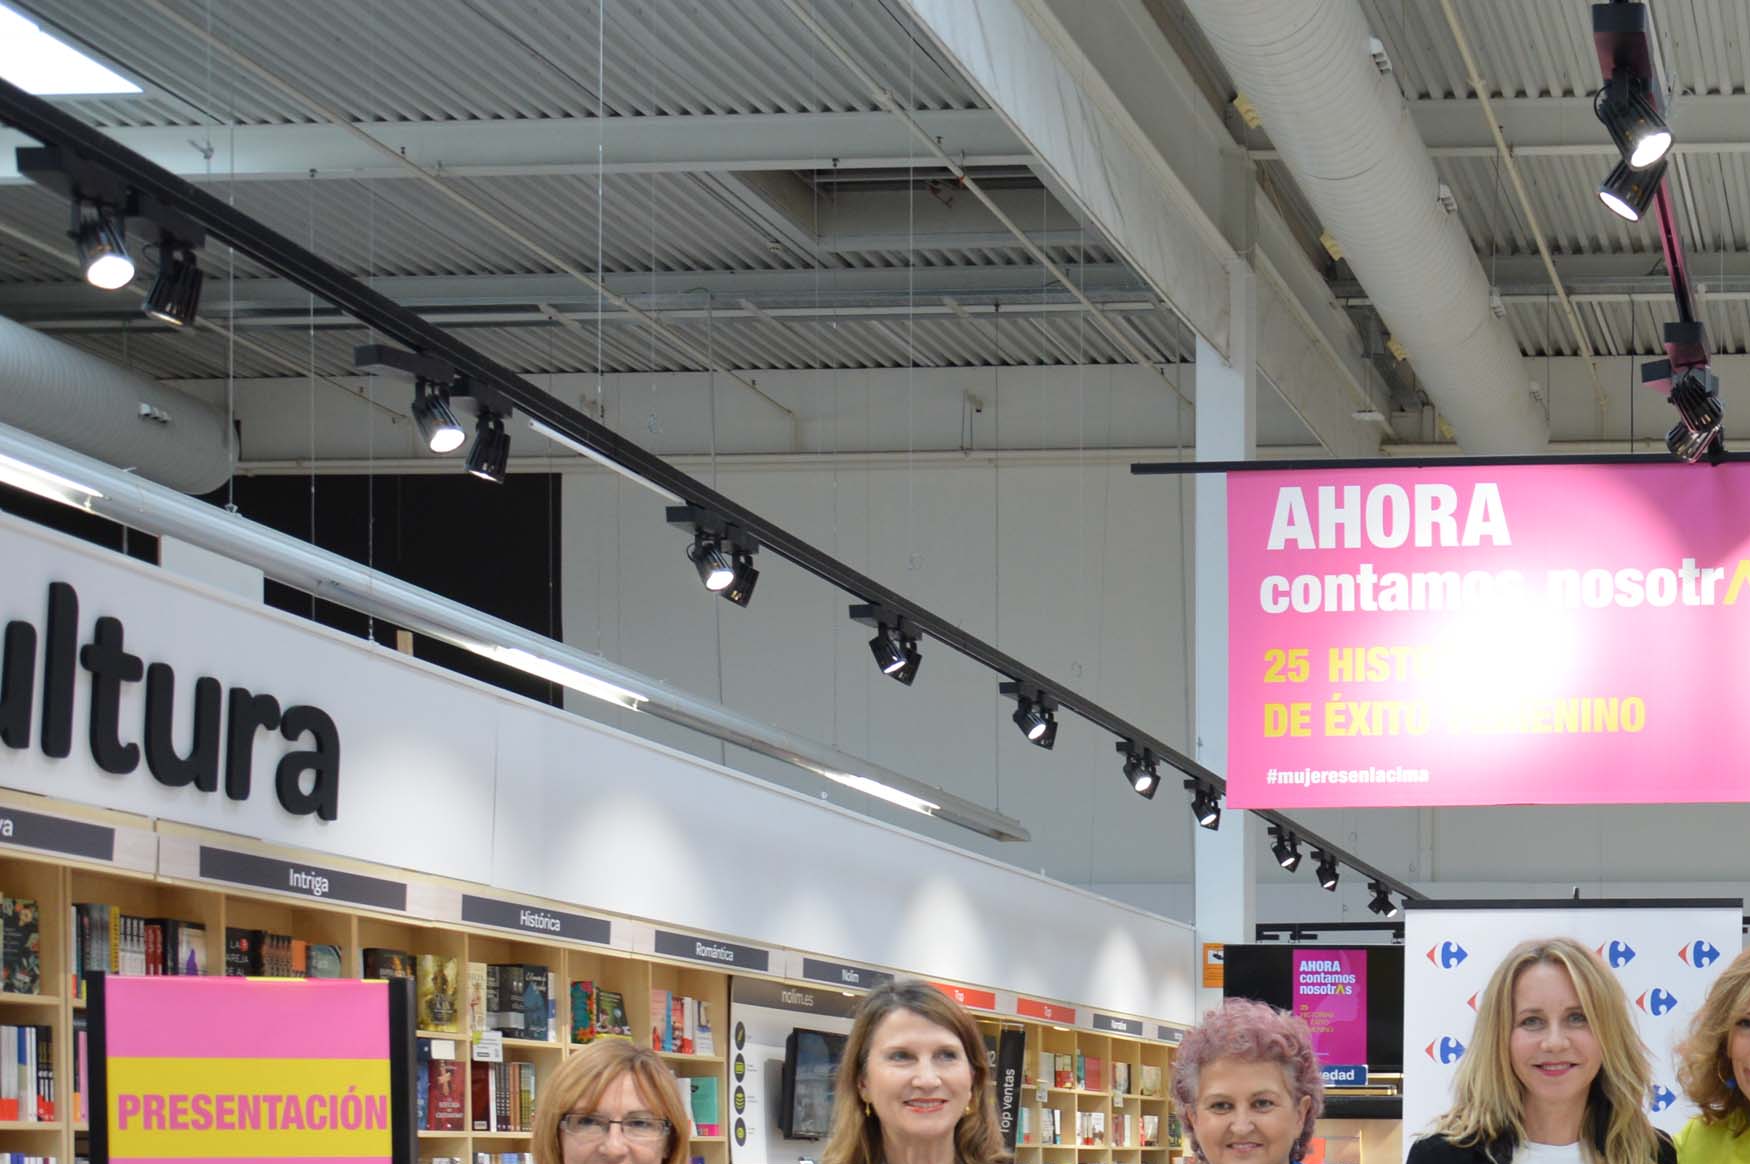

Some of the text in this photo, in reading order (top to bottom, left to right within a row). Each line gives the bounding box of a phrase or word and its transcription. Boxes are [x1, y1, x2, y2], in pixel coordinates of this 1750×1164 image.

[1267, 482, 1512, 550] AHORA
[1264, 647, 1310, 683] 25
[1264, 702, 1312, 737] DE
[1324, 692, 1430, 737] ÉXITO
[1266, 766, 1430, 787] #mujeresenlacima
[289, 868, 329, 896] Intriga
[519, 910, 561, 932] Histórica
[695, 942, 734, 961] Romántica
[1299, 960, 1341, 972] AHORA
[1300, 973, 1356, 983] contamos
[118, 1085, 388, 1130] PRESENTACIÓN
[1000, 1068, 1016, 1134] Top ventas
